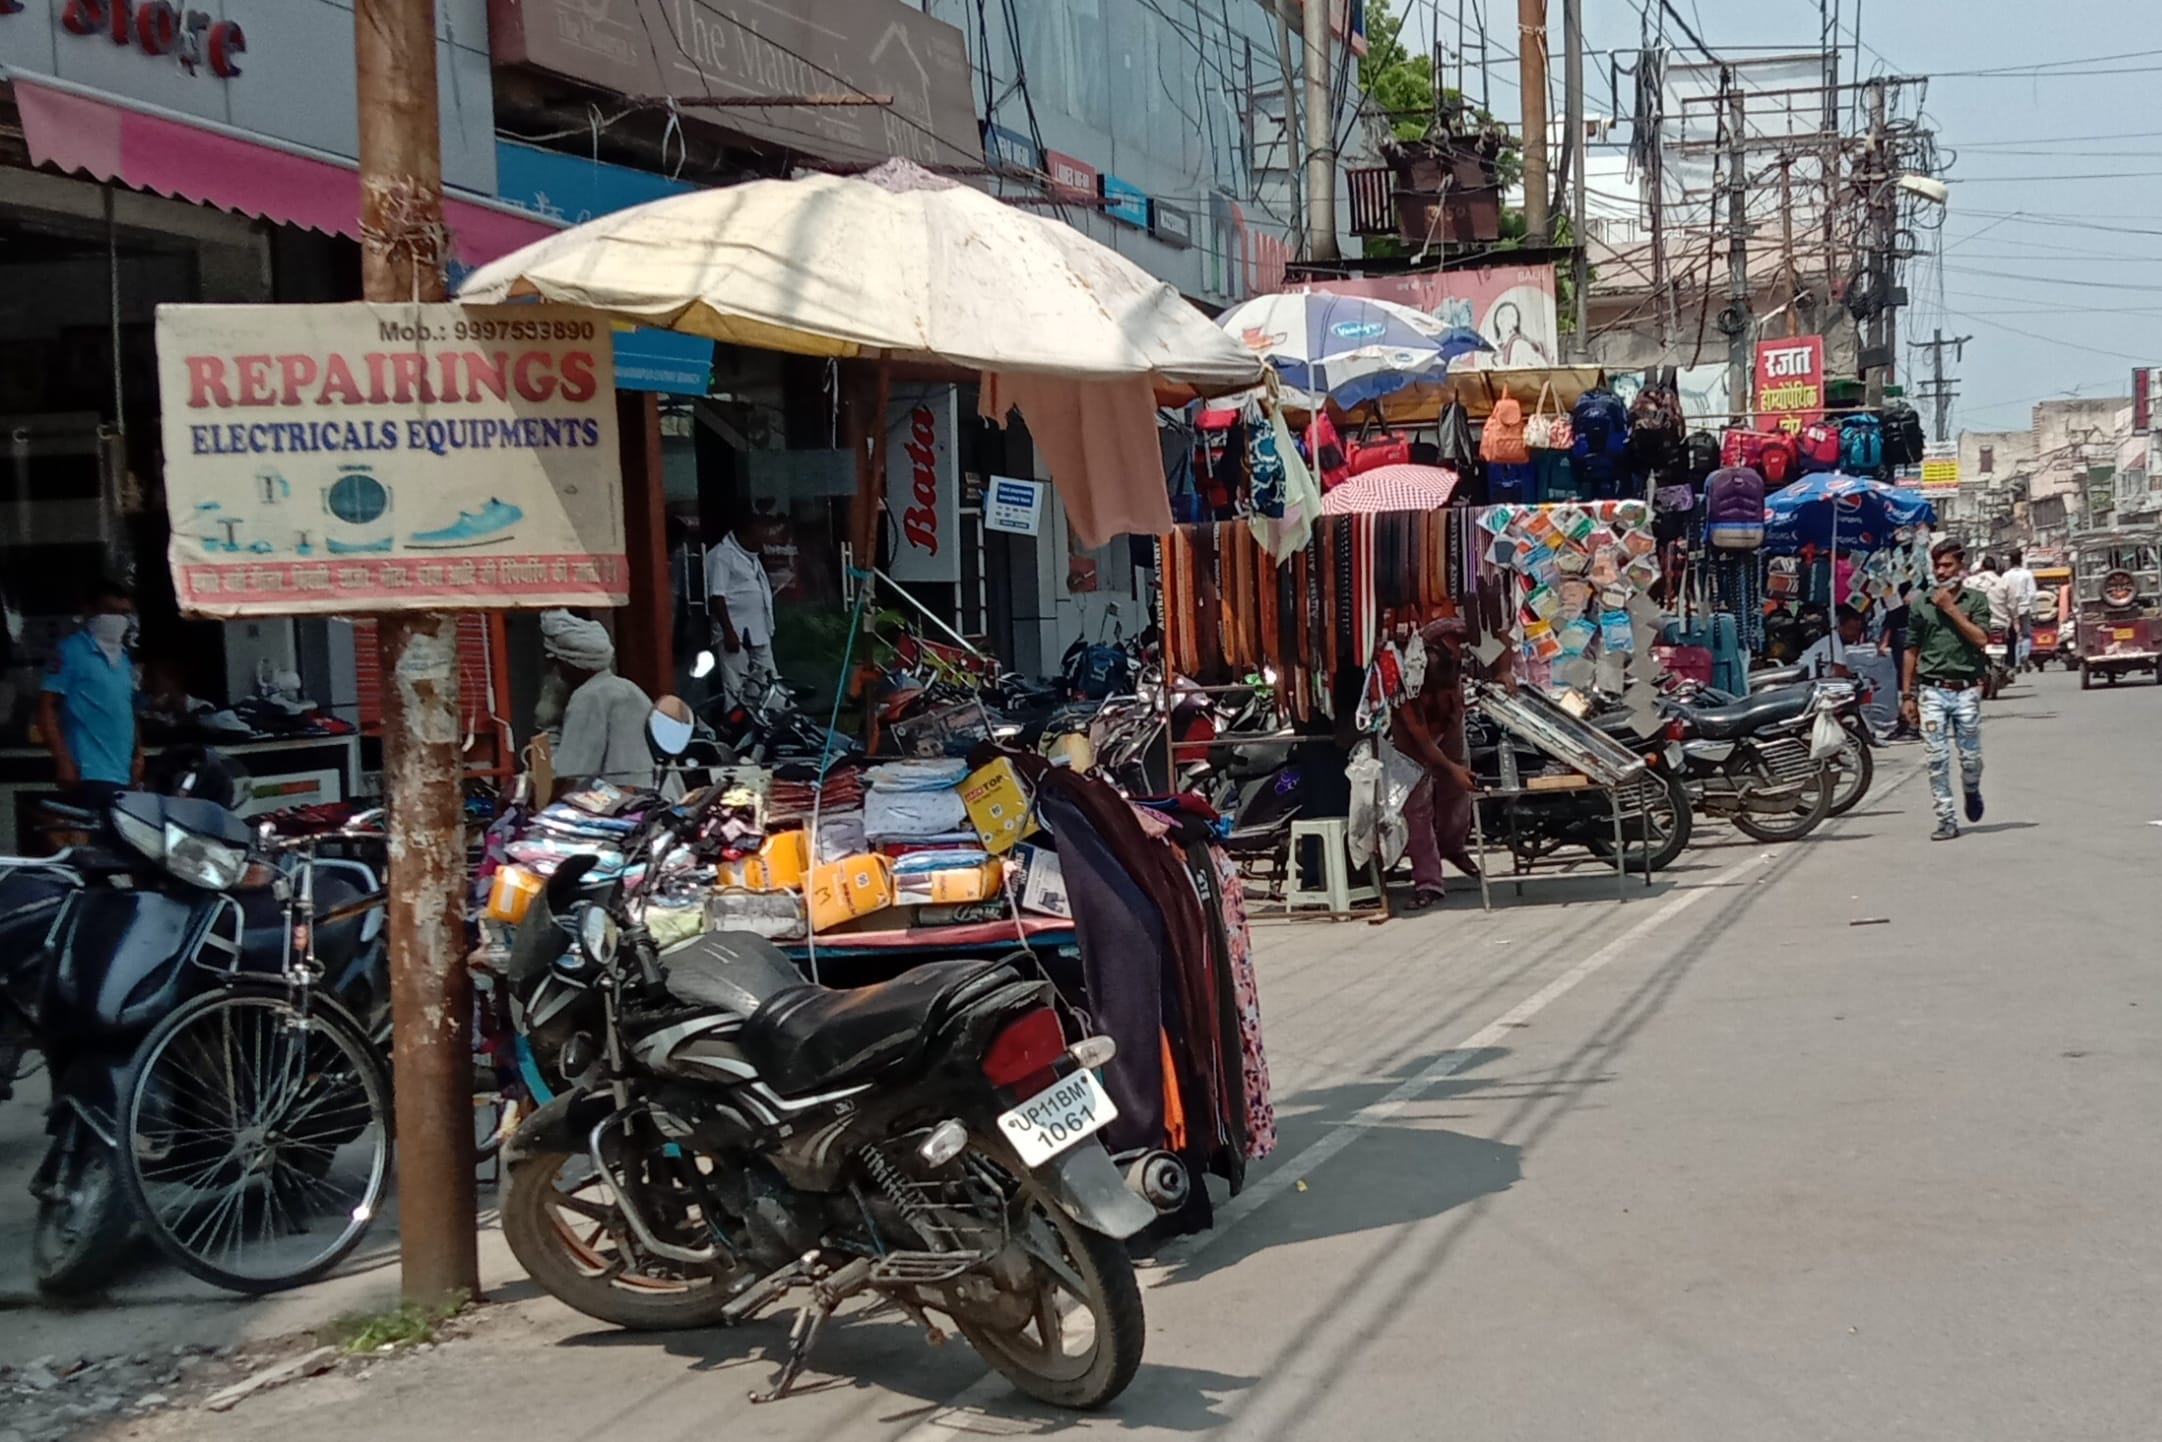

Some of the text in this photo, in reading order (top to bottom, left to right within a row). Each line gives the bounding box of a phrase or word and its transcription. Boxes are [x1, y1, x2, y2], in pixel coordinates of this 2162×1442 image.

[184, 350, 598, 409] REPAIRINGS
[1762, 345, 1813, 378] रजत
[189, 417, 599, 456] ELECTRICALS EQUIPMENTS
[903, 403, 938, 557] Bata
[1015, 1081, 1087, 1132] UP11BM
[1037, 1104, 1096, 1149] 1061
